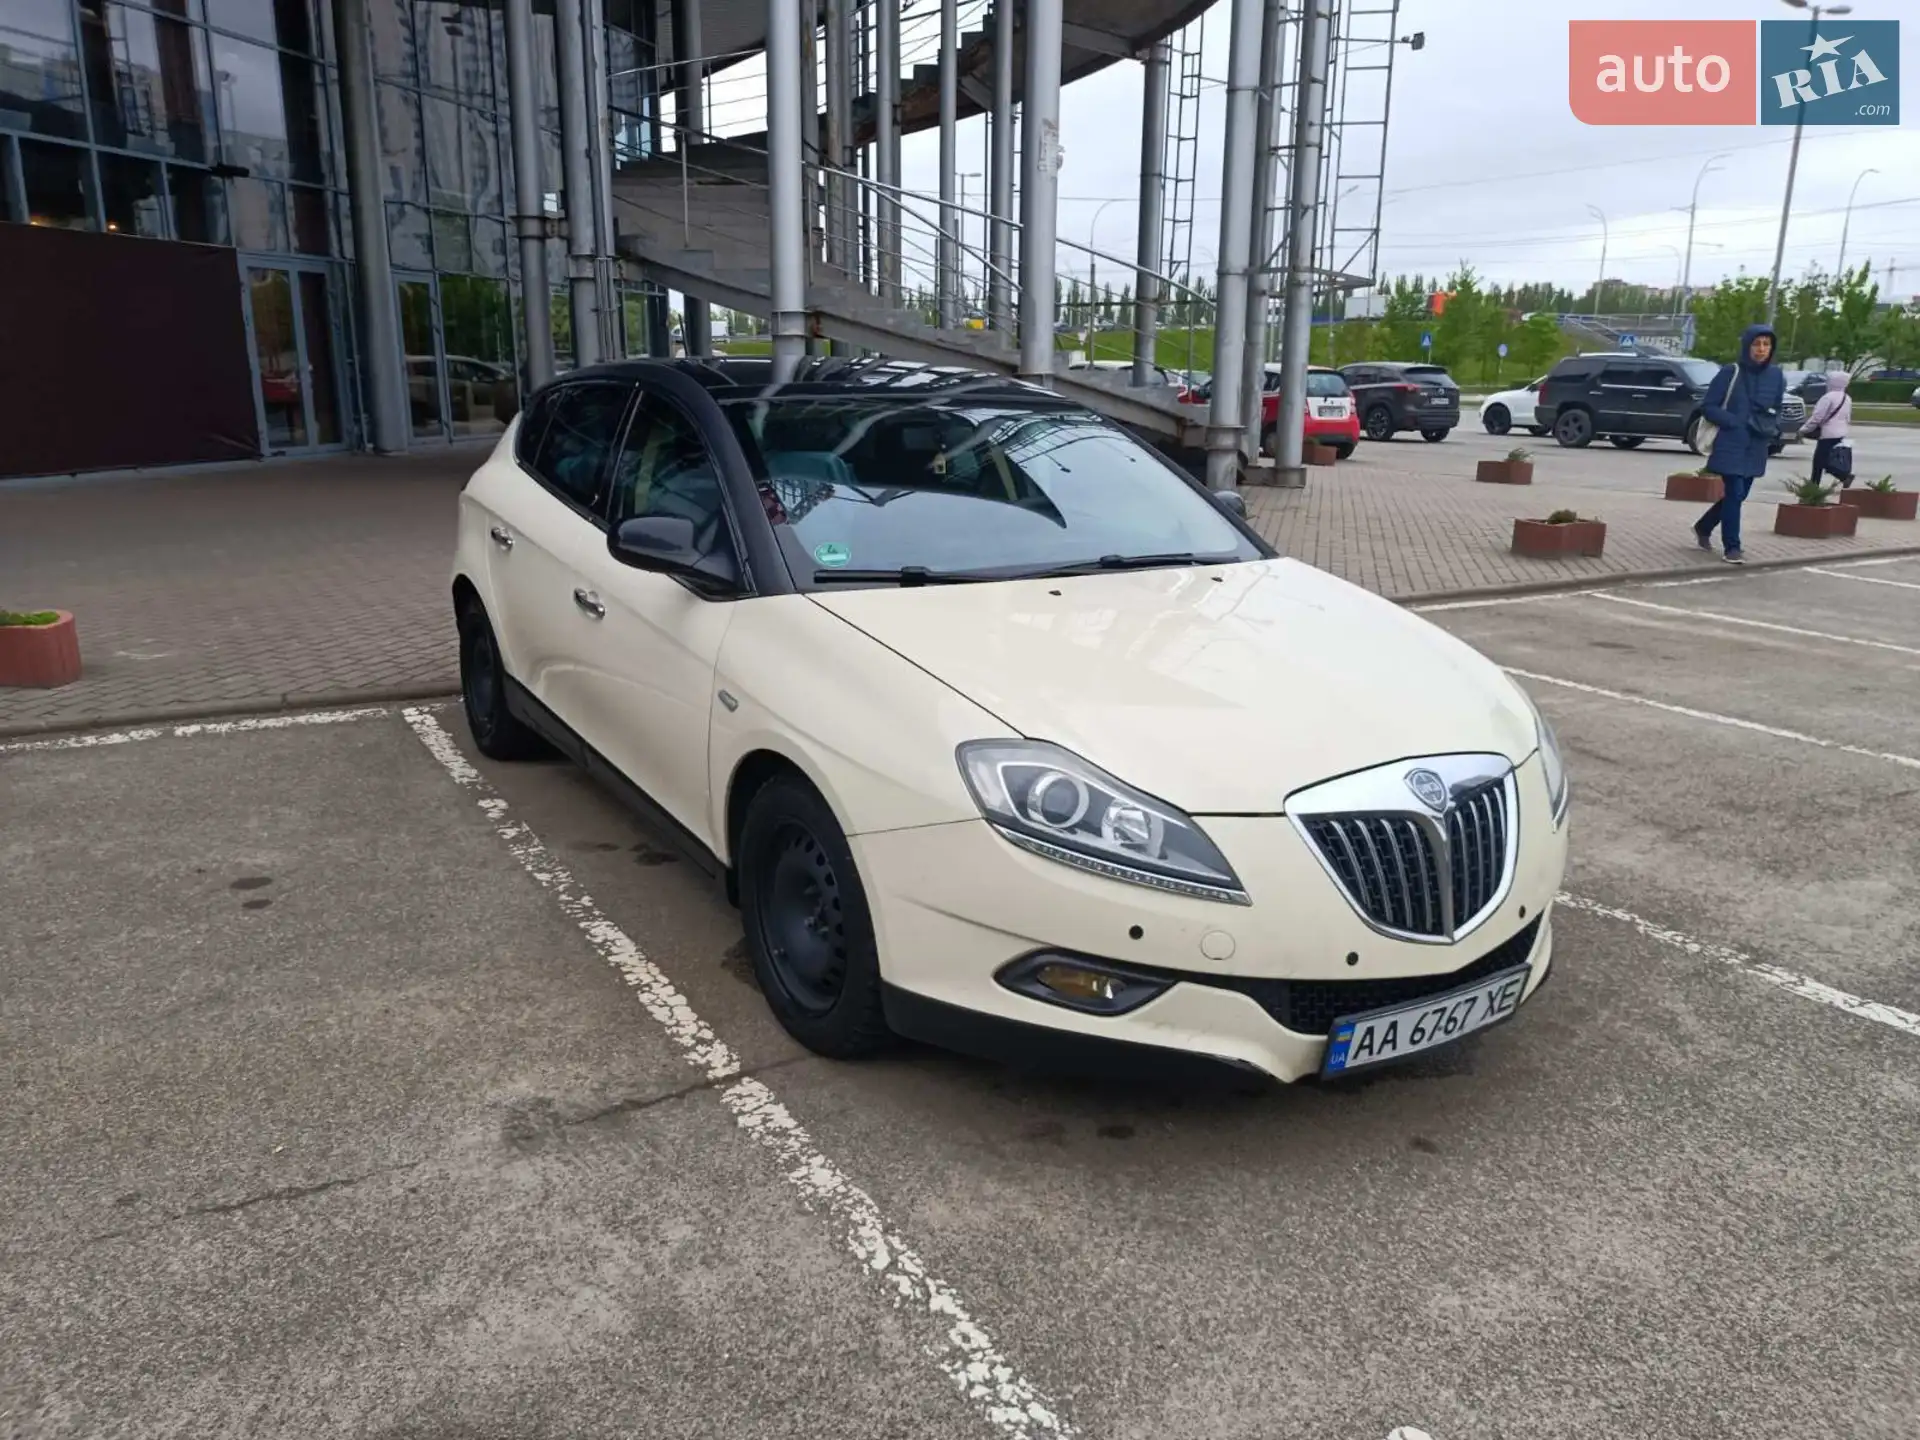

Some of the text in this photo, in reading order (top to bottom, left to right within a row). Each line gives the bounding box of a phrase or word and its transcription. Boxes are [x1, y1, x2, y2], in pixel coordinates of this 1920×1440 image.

[1352, 978, 1521, 1060] AA 6767 XE
[1331, 1051, 1346, 1065] UA
